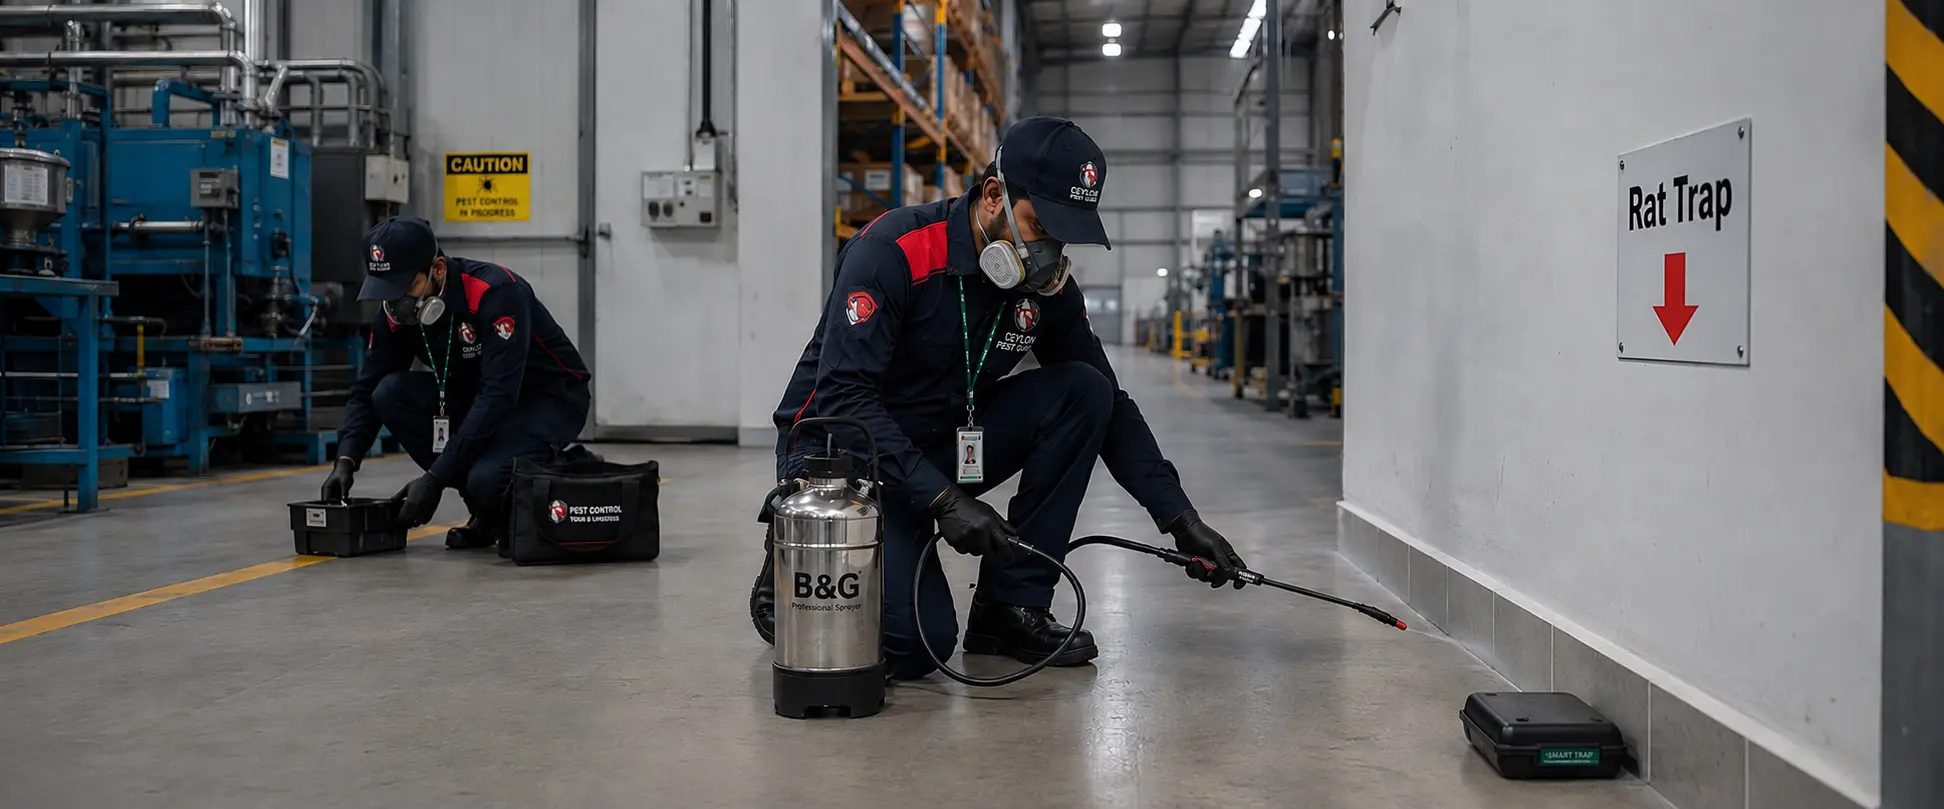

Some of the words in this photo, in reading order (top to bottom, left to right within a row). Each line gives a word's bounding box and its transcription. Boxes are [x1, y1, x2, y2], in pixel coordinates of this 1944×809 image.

[451, 157, 523, 172] CAUTION
[456, 197, 477, 206] PEST
[479, 197, 519, 206] CONTROL
[1629, 182, 1666, 231] Rat
[1673, 175, 1732, 231] Trap
[1005, 332, 1036, 344] CEYLON
[996, 341, 1016, 351] PEST
[569, 506, 588, 515] PEST
[589, 506, 622, 515] CONTROL
[794, 572, 859, 599] B&G
[791, 602, 833, 611] Professional
[1574, 751, 1594, 759] TRAP
